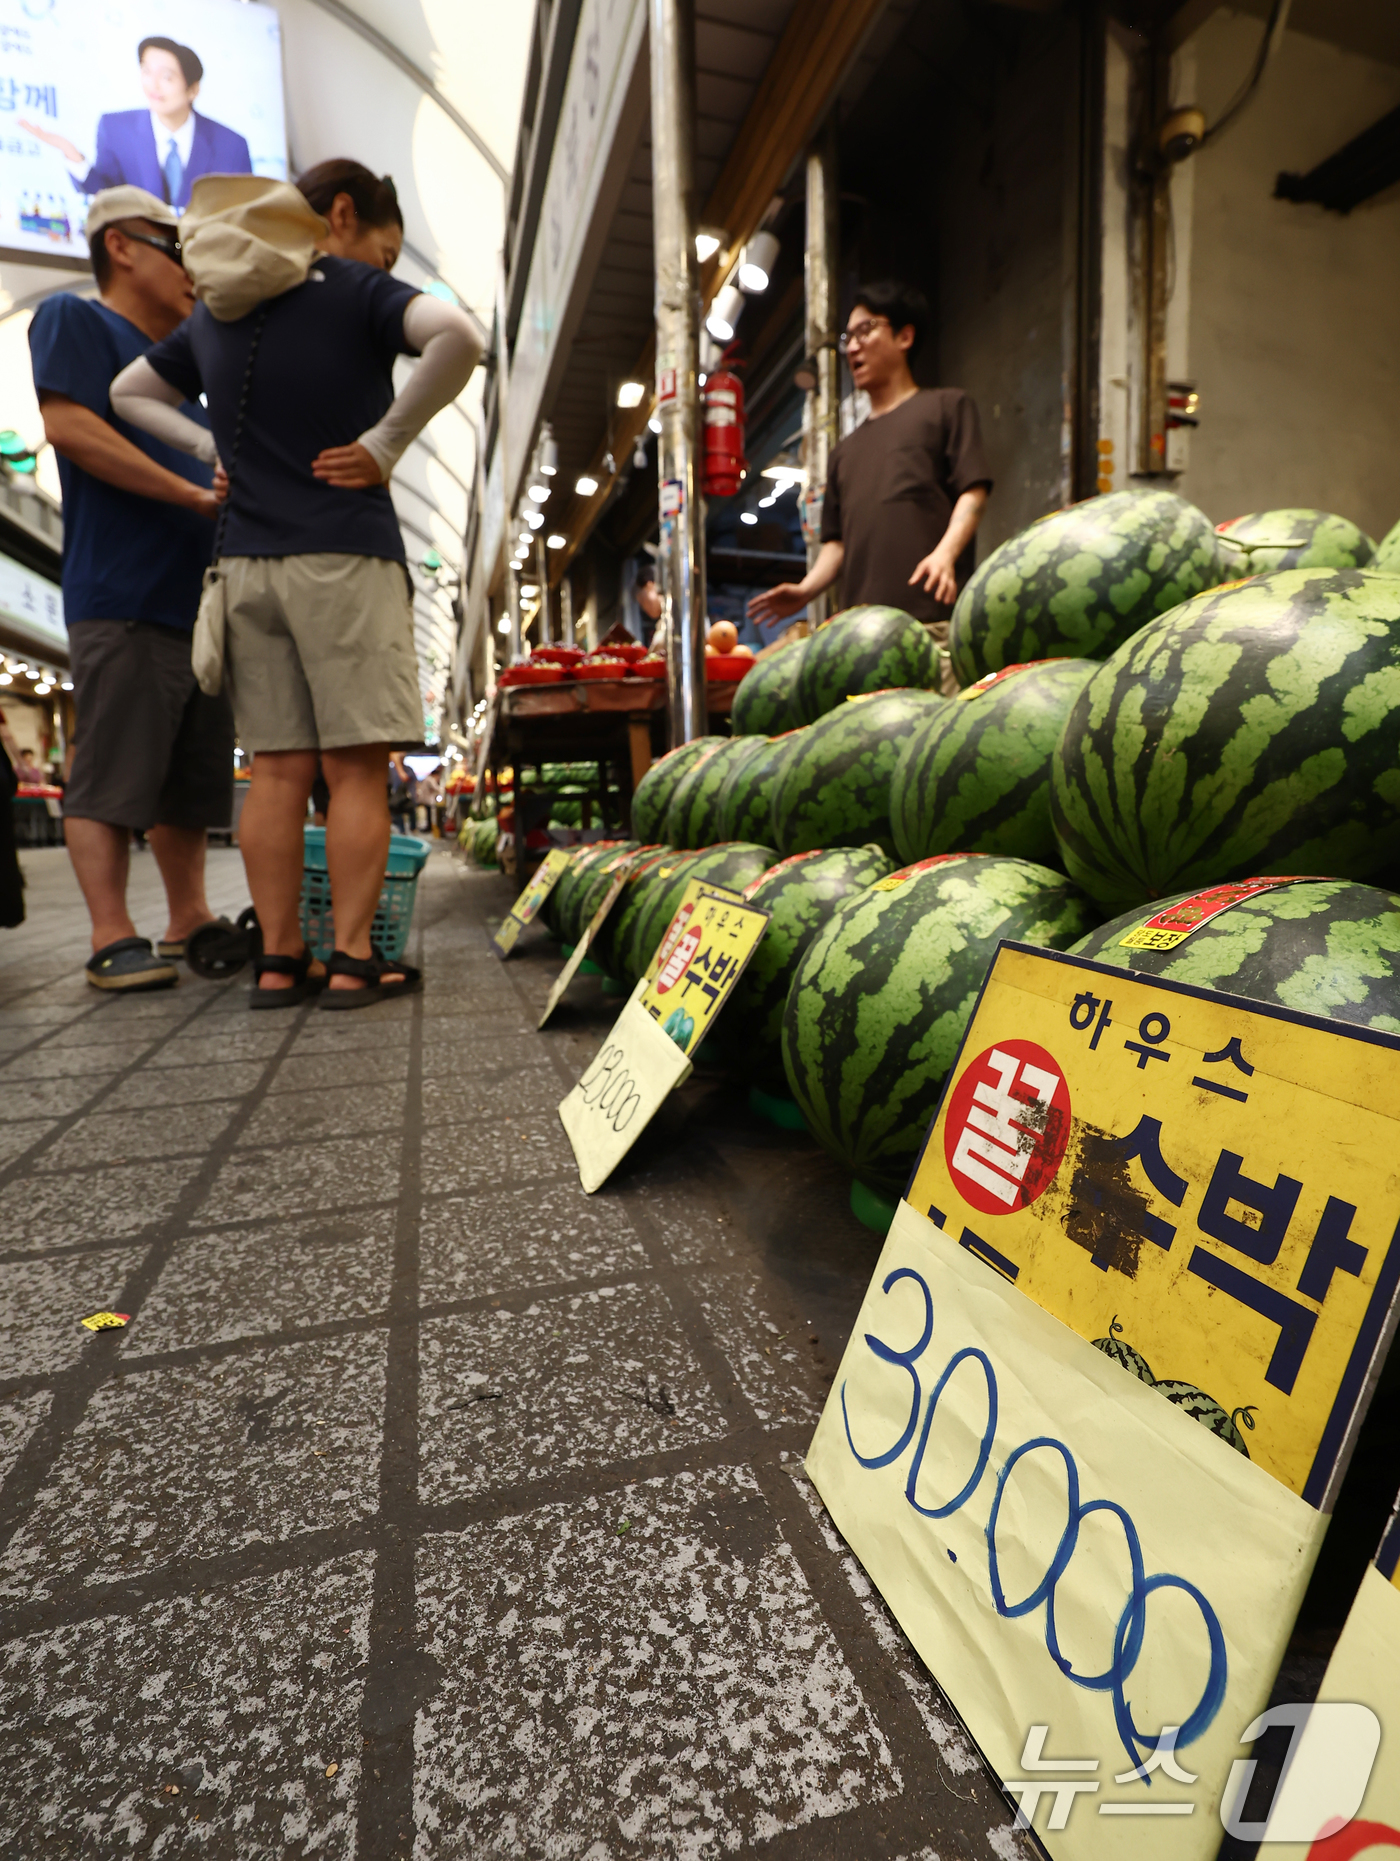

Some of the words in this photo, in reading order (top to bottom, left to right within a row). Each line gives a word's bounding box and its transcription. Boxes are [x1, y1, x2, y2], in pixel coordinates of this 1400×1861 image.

[659, 932, 701, 989] 꿀
[681, 946, 739, 1015] 수박
[1068, 991, 1256, 1103] 하우스
[951, 1049, 1060, 1206] 꿀
[1064, 1114, 1369, 1396] 수박
